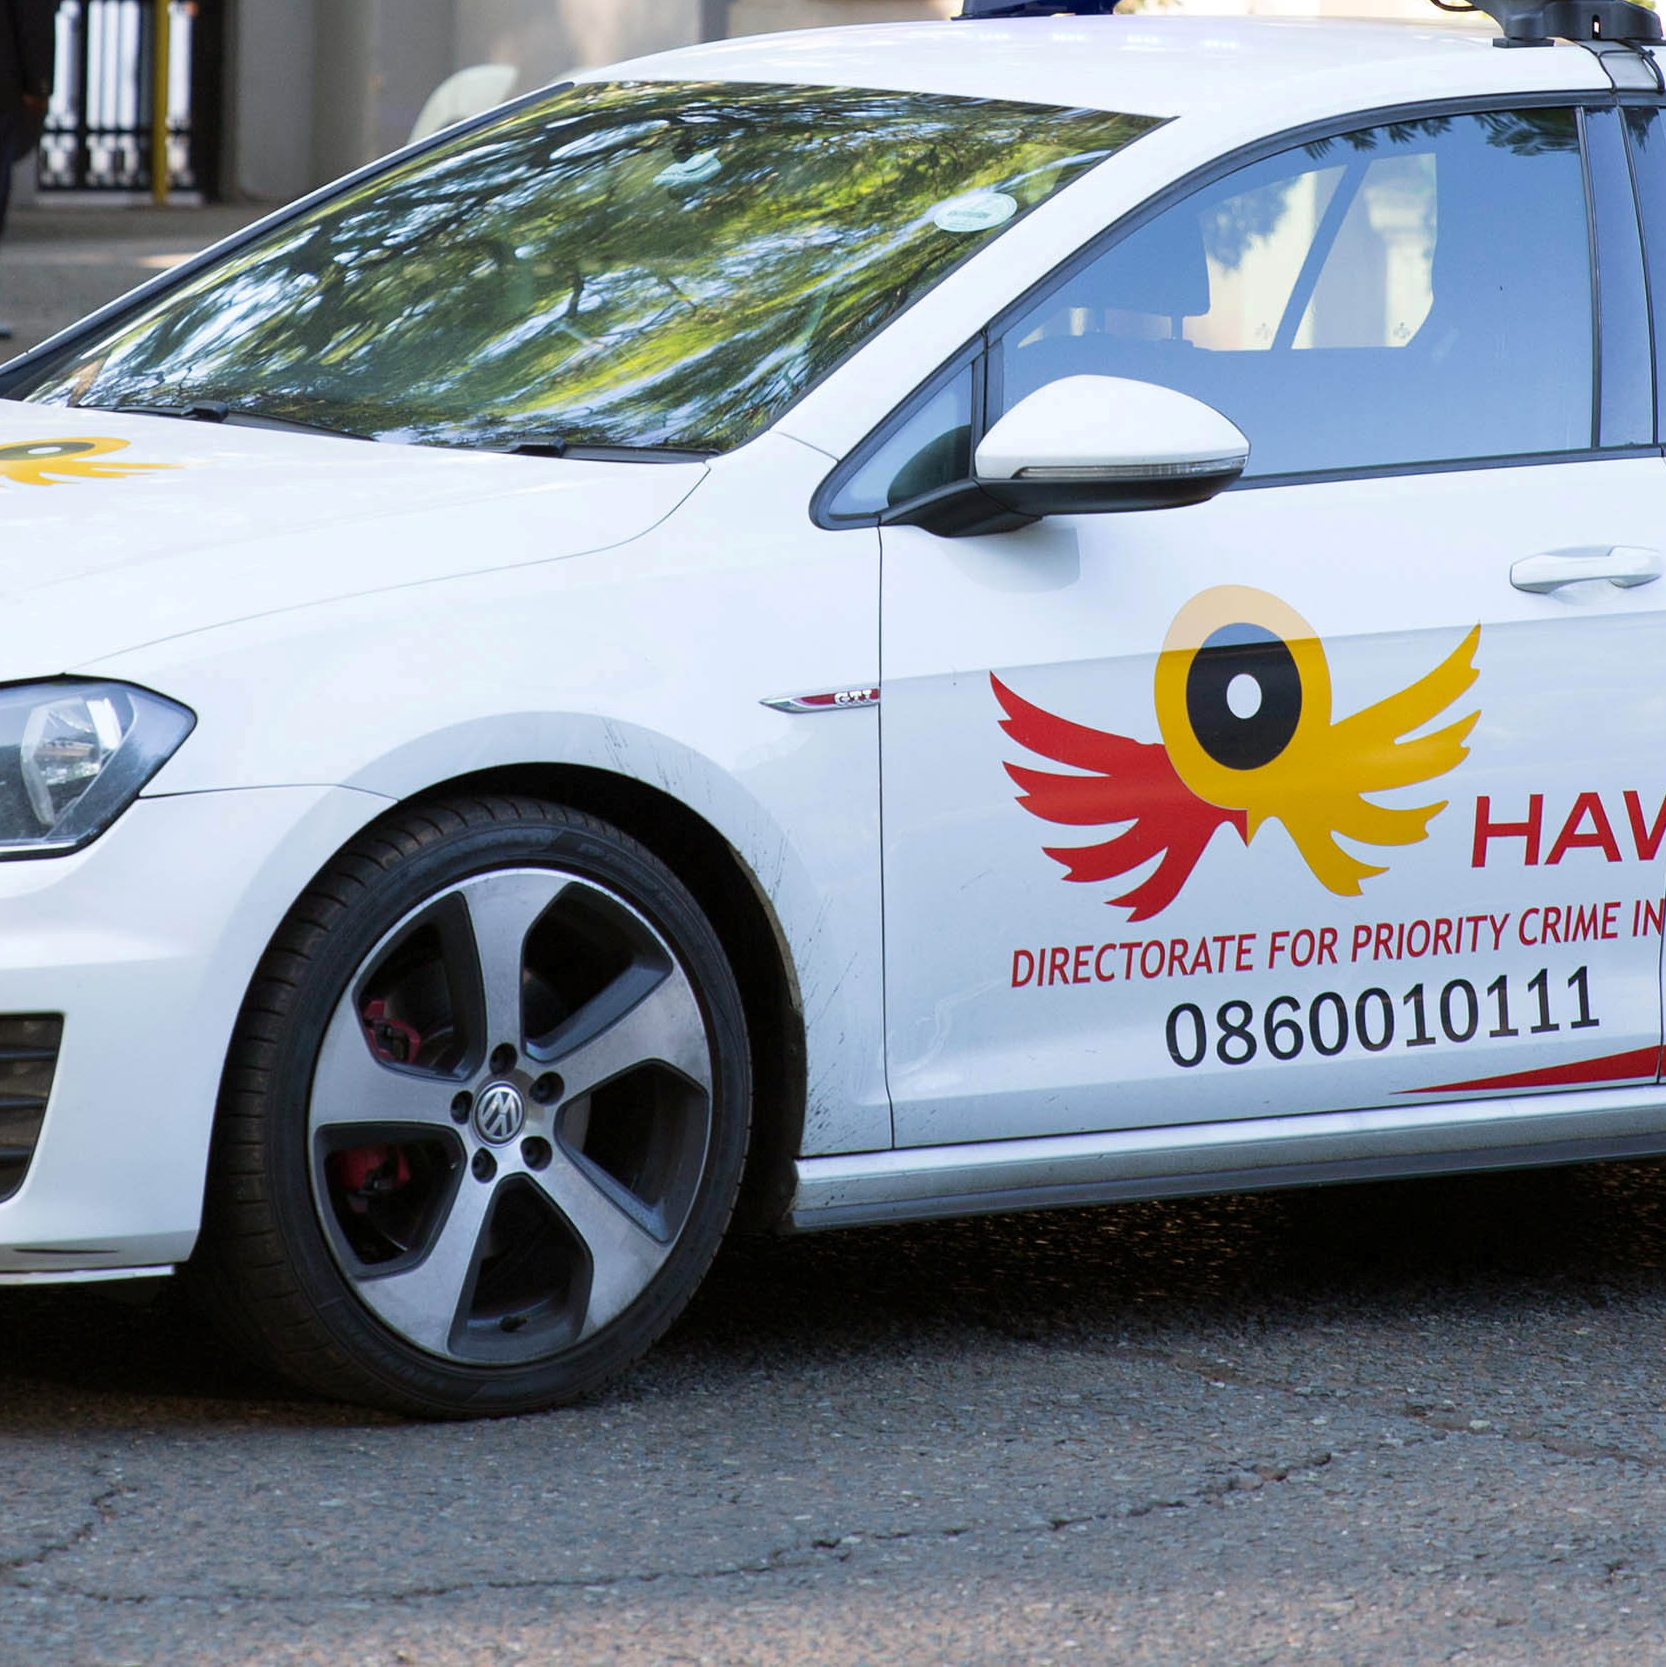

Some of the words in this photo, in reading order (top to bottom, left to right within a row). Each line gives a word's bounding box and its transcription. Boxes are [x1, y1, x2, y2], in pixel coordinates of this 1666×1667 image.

[1012, 933, 1256, 987] DIRECTORATE
[1268, 926, 1338, 968] FOR
[1351, 912, 1510, 962] PRIORITY
[1518, 901, 1620, 945] CRIME
[1165, 965, 1600, 1068] 0860010111
